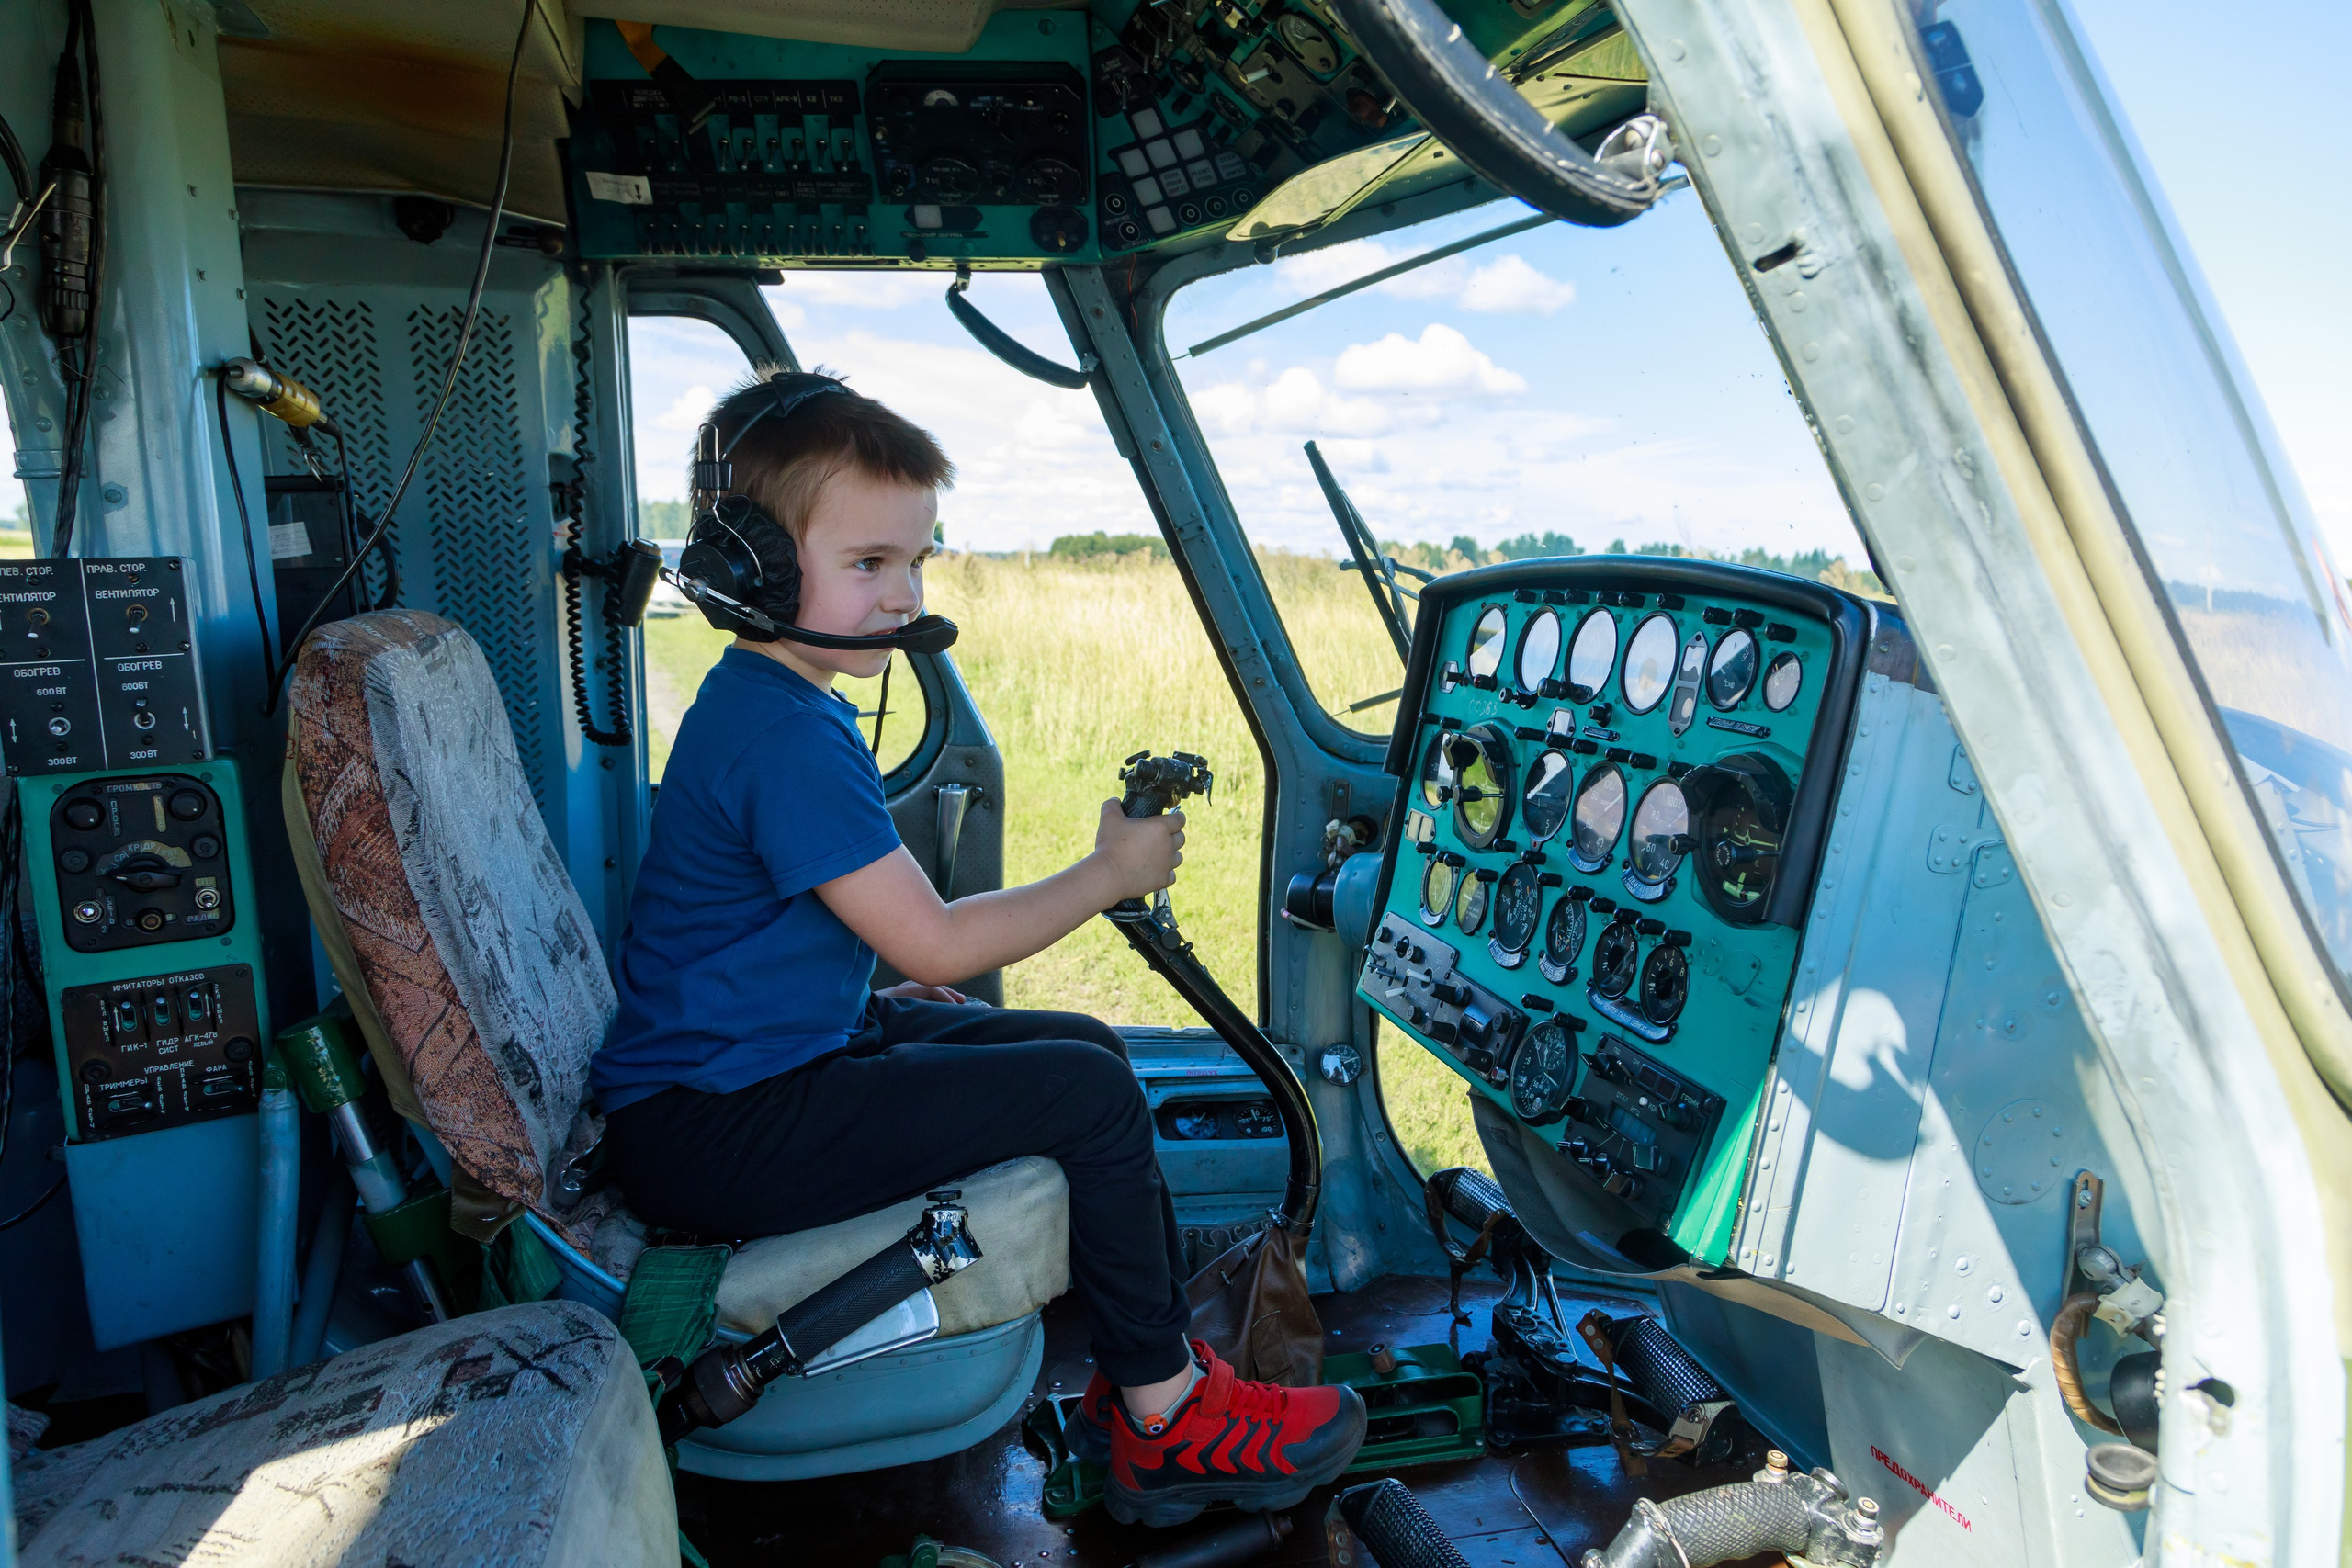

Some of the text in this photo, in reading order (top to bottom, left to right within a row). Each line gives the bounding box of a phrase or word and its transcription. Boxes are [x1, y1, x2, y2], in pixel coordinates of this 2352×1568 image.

[25, 566, 54, 577] СТОР.
[86, 563, 147, 574] ПРАВ. СТОР.
[0, 592, 57, 603] ЕНТИЛЯТОР
[95, 588, 160, 599] ВЕНТИЛЯТОР
[117, 661, 163, 672] ОБОГРЕВ
[13, 667, 61, 678] ОБОГРЕВ
[107, 783, 163, 794] ГРОМКОСТЬ
[1590, 790, 1600, 801] 80
[1666, 797, 1683, 809] 100%
[1650, 810, 1661, 822] 80
[1595, 837, 1605, 848] 40
[1645, 842, 1657, 854] 60
[1659, 859, 1670, 870] 40
[1620, 934, 1625, 944] 6
[1629, 942, 1635, 952] 8
[1668, 957, 1674, 967] 6
[1679, 967, 1685, 977] 8
[112, 973, 206, 993] ИМИТАТОРЫ ОТКАЗОВ
[155, 1037, 180, 1048] ГИДР
[120, 1043, 148, 1054] ГИК-1
[158, 1046, 180, 1055] СИСТ
[143, 1059, 195, 1076] УПРАВЛЕНИЕ
[205, 1063, 228, 1074] ФАРА
[99, 1077, 149, 1092] ТРИММЕРЫ
[1870, 1444, 1973, 1534] ПРЕДОХРАНИТЕЛИ
